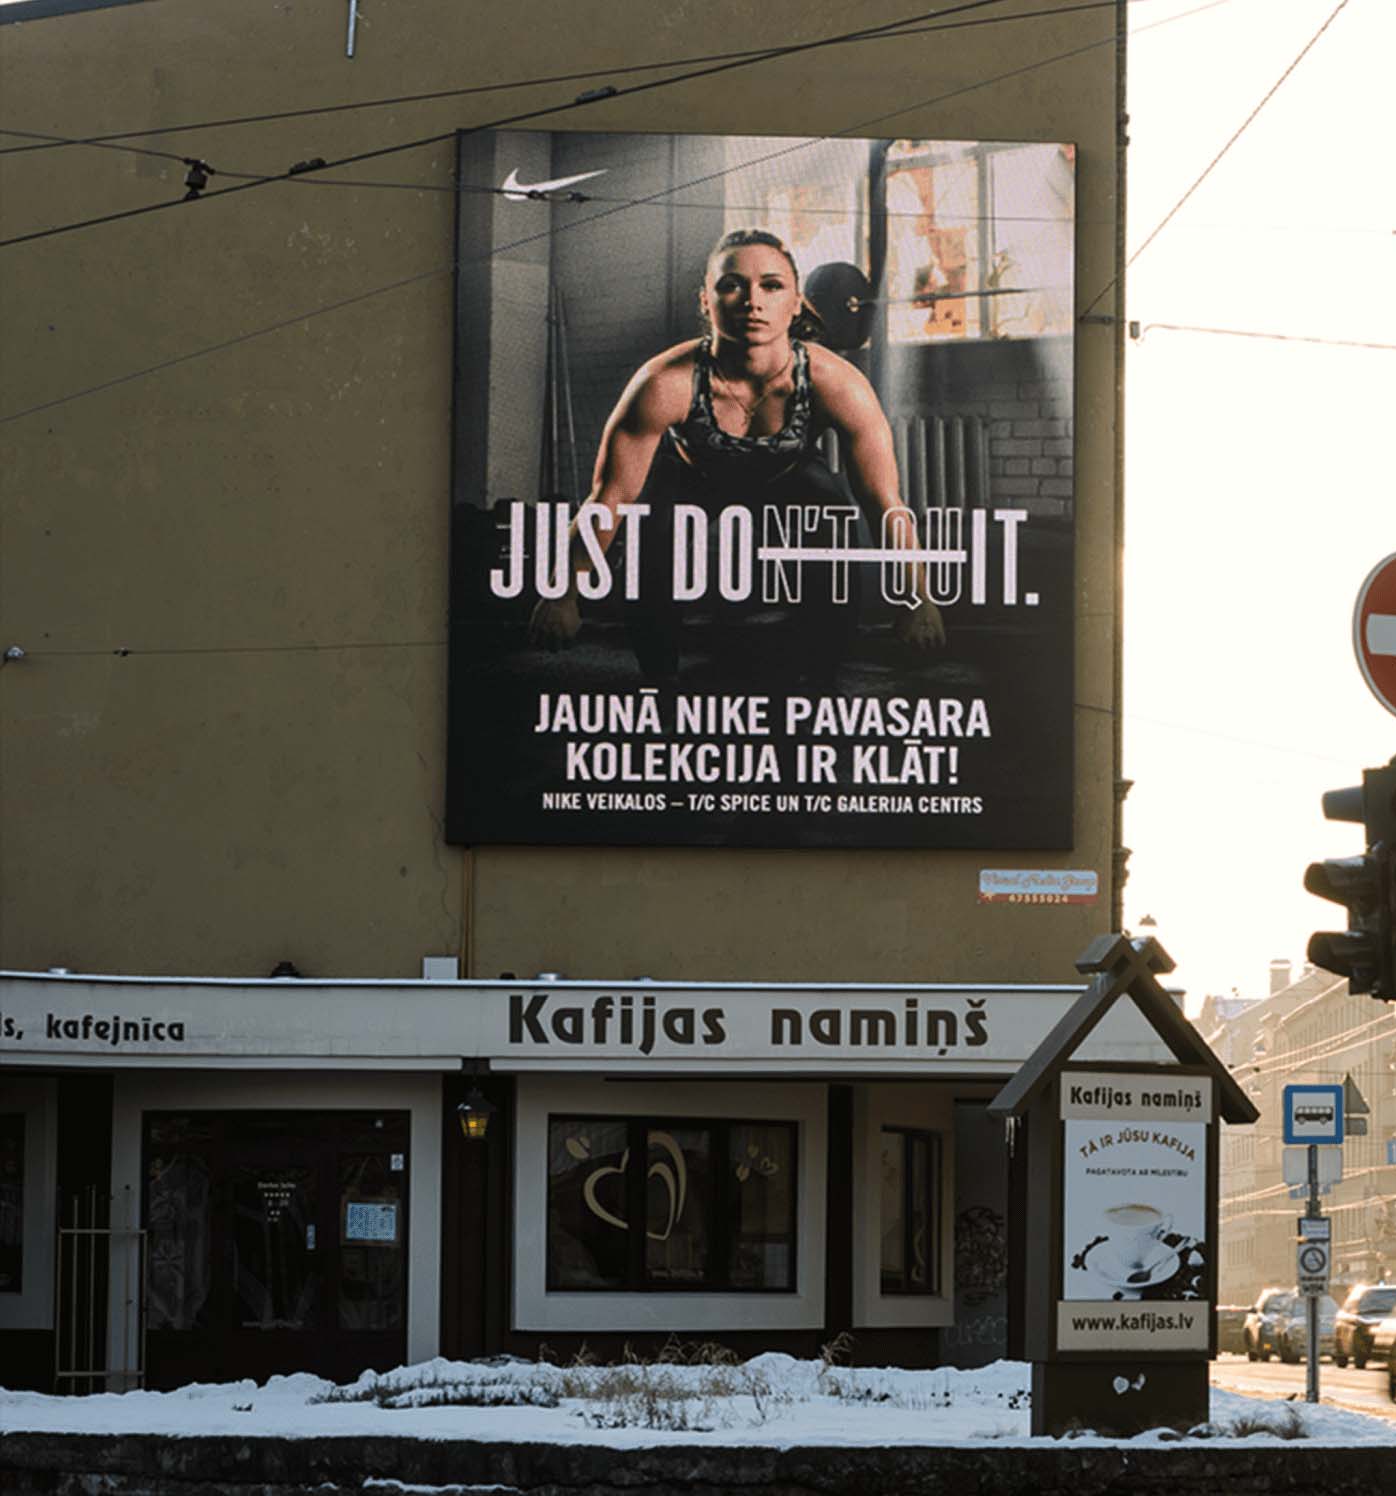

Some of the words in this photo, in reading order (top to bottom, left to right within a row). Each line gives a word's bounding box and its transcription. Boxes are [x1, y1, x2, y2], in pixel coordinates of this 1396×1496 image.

[490, 502, 651, 600] JUST
[673, 504, 860, 603] DON'T
[881, 506, 1040, 610] QUIT.
[534, 688, 662, 734] JAUNĀ
[677, 696, 770, 735] NIKE
[786, 697, 991, 737] PAVASARA
[566, 741, 781, 783] KOLEKCIJA
[797, 745, 837, 783] IR
[853, 739, 959, 785] KLĀT!
[543, 793, 581, 810] NIKE
[587, 793, 666, 811] VEIKALOS
[688, 794, 716, 811] T/C
[720, 794, 771, 812] SPICE
[776, 795, 799, 811] UN
[804, 795, 832, 812] T/C
[837, 796, 914, 813] GALERIJA
[918, 796, 983, 814] CENTRS
[46, 1013, 185, 1046] kafejnīca
[508, 994, 726, 1056] Kafijas
[771, 998, 989, 1056] namiņš
[1070, 1086, 1132, 1109] Kafijas
[1141, 1090, 1202, 1112] namiņš
[1100, 1134, 1113, 1148] IR
[1117, 1128, 1149, 1144] JŪSU
[1152, 1132, 1196, 1161] KAFIJA
[1072, 1312, 1194, 1333] www.kafijas.lv
